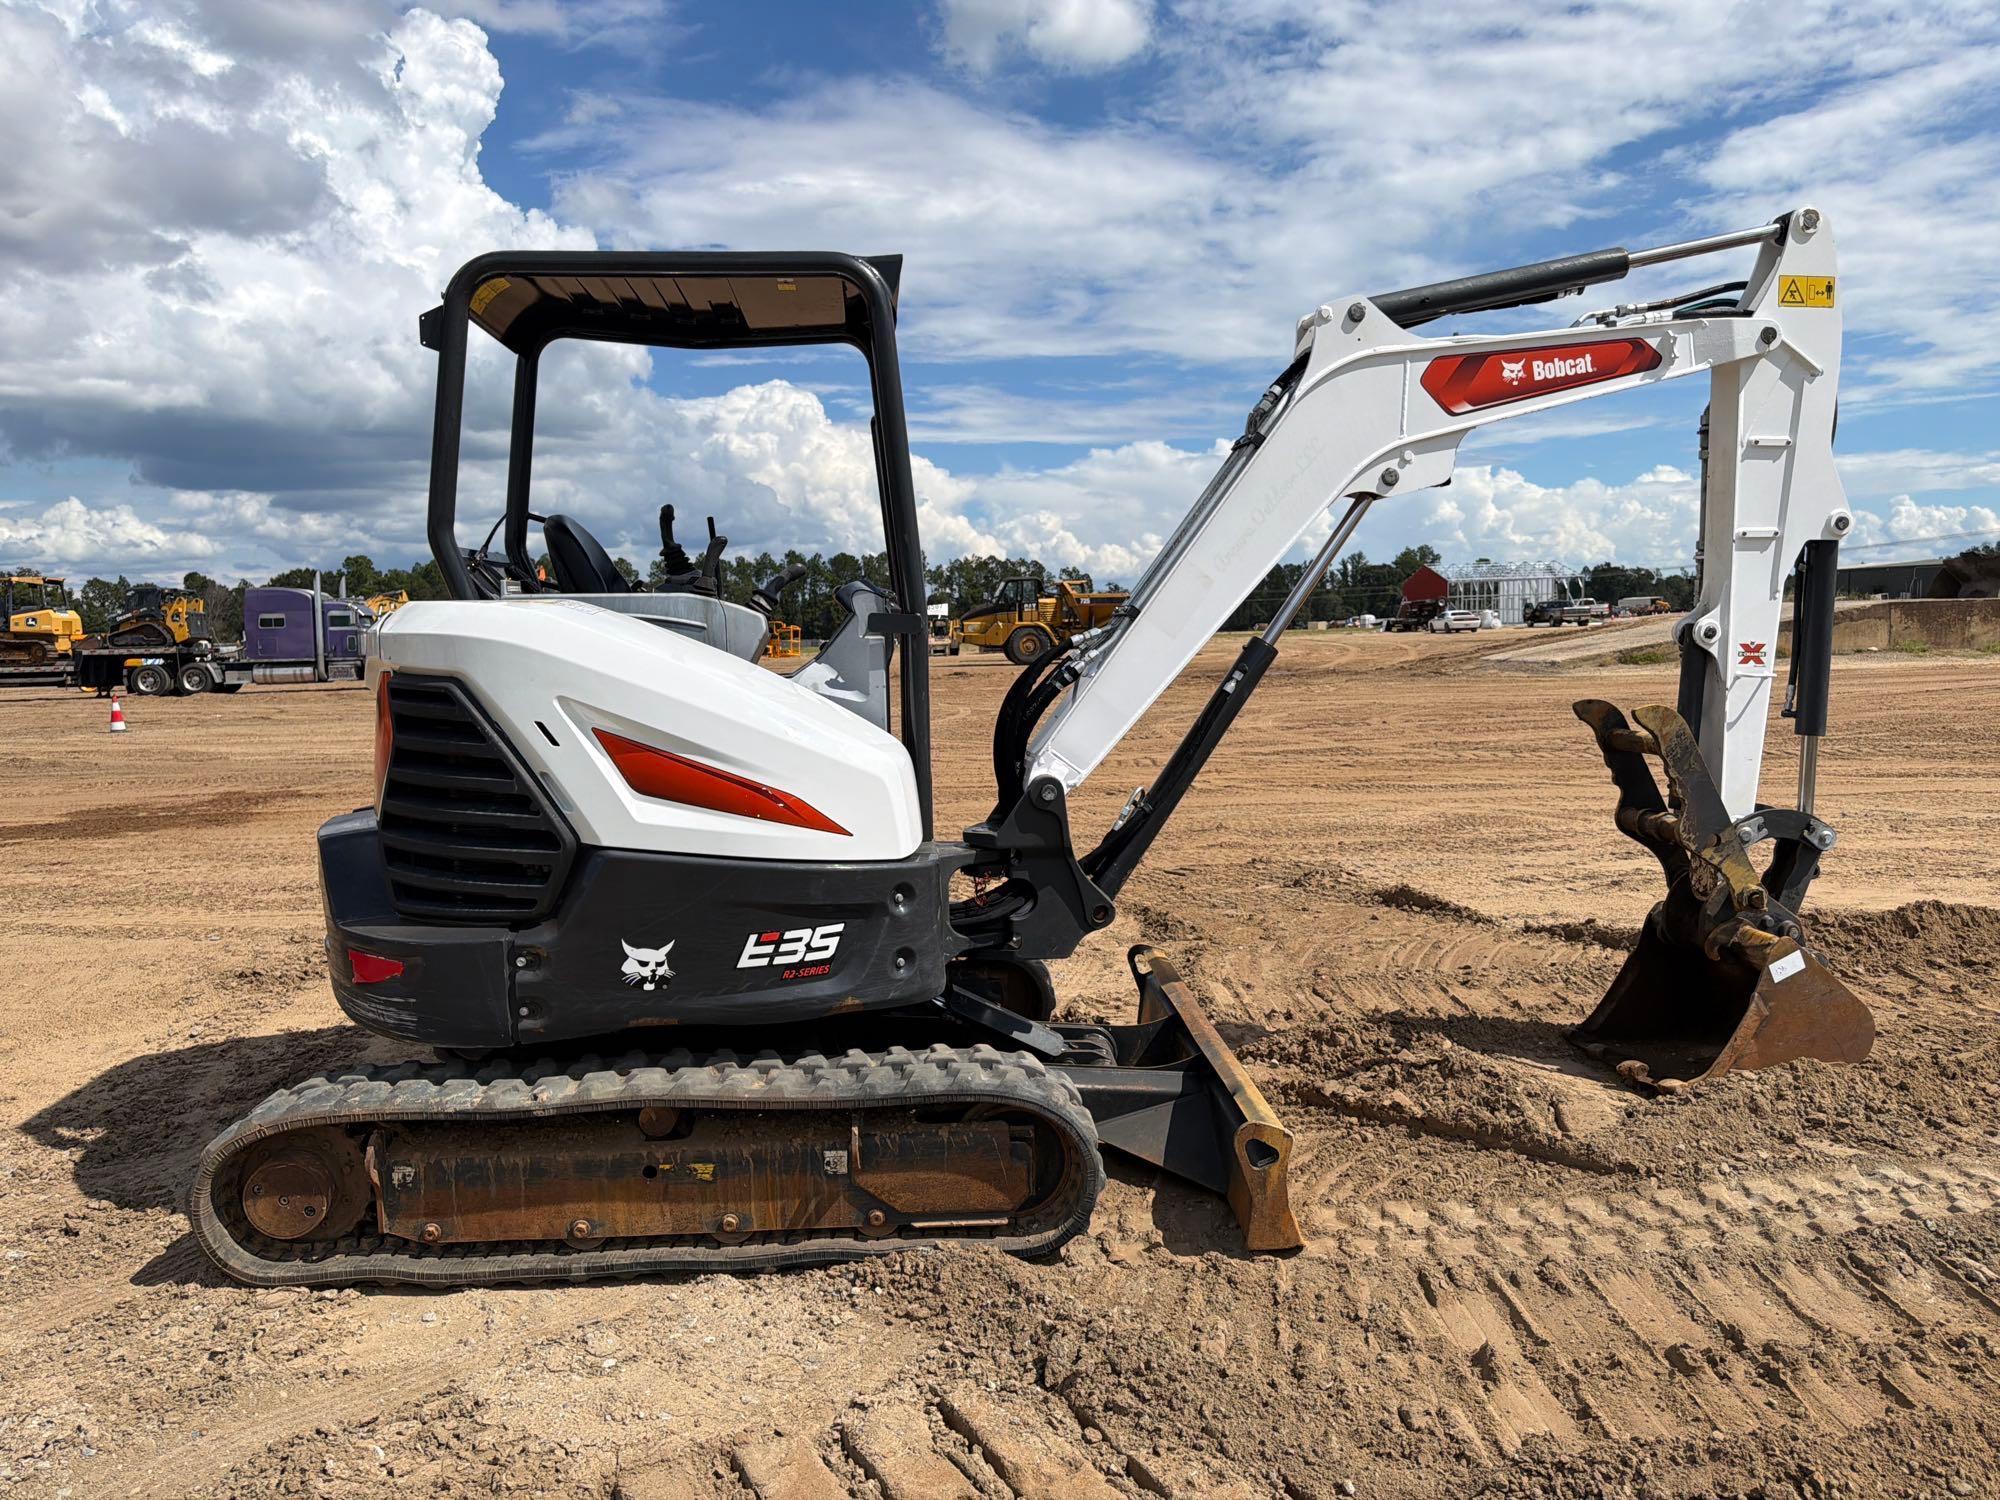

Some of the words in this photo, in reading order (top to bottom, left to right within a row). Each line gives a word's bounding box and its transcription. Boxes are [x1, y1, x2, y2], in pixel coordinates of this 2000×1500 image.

[1532, 353, 1593, 381] Bobcat
[736, 922, 845, 968] E35
[782, 964, 830, 979] R2-SERIES
